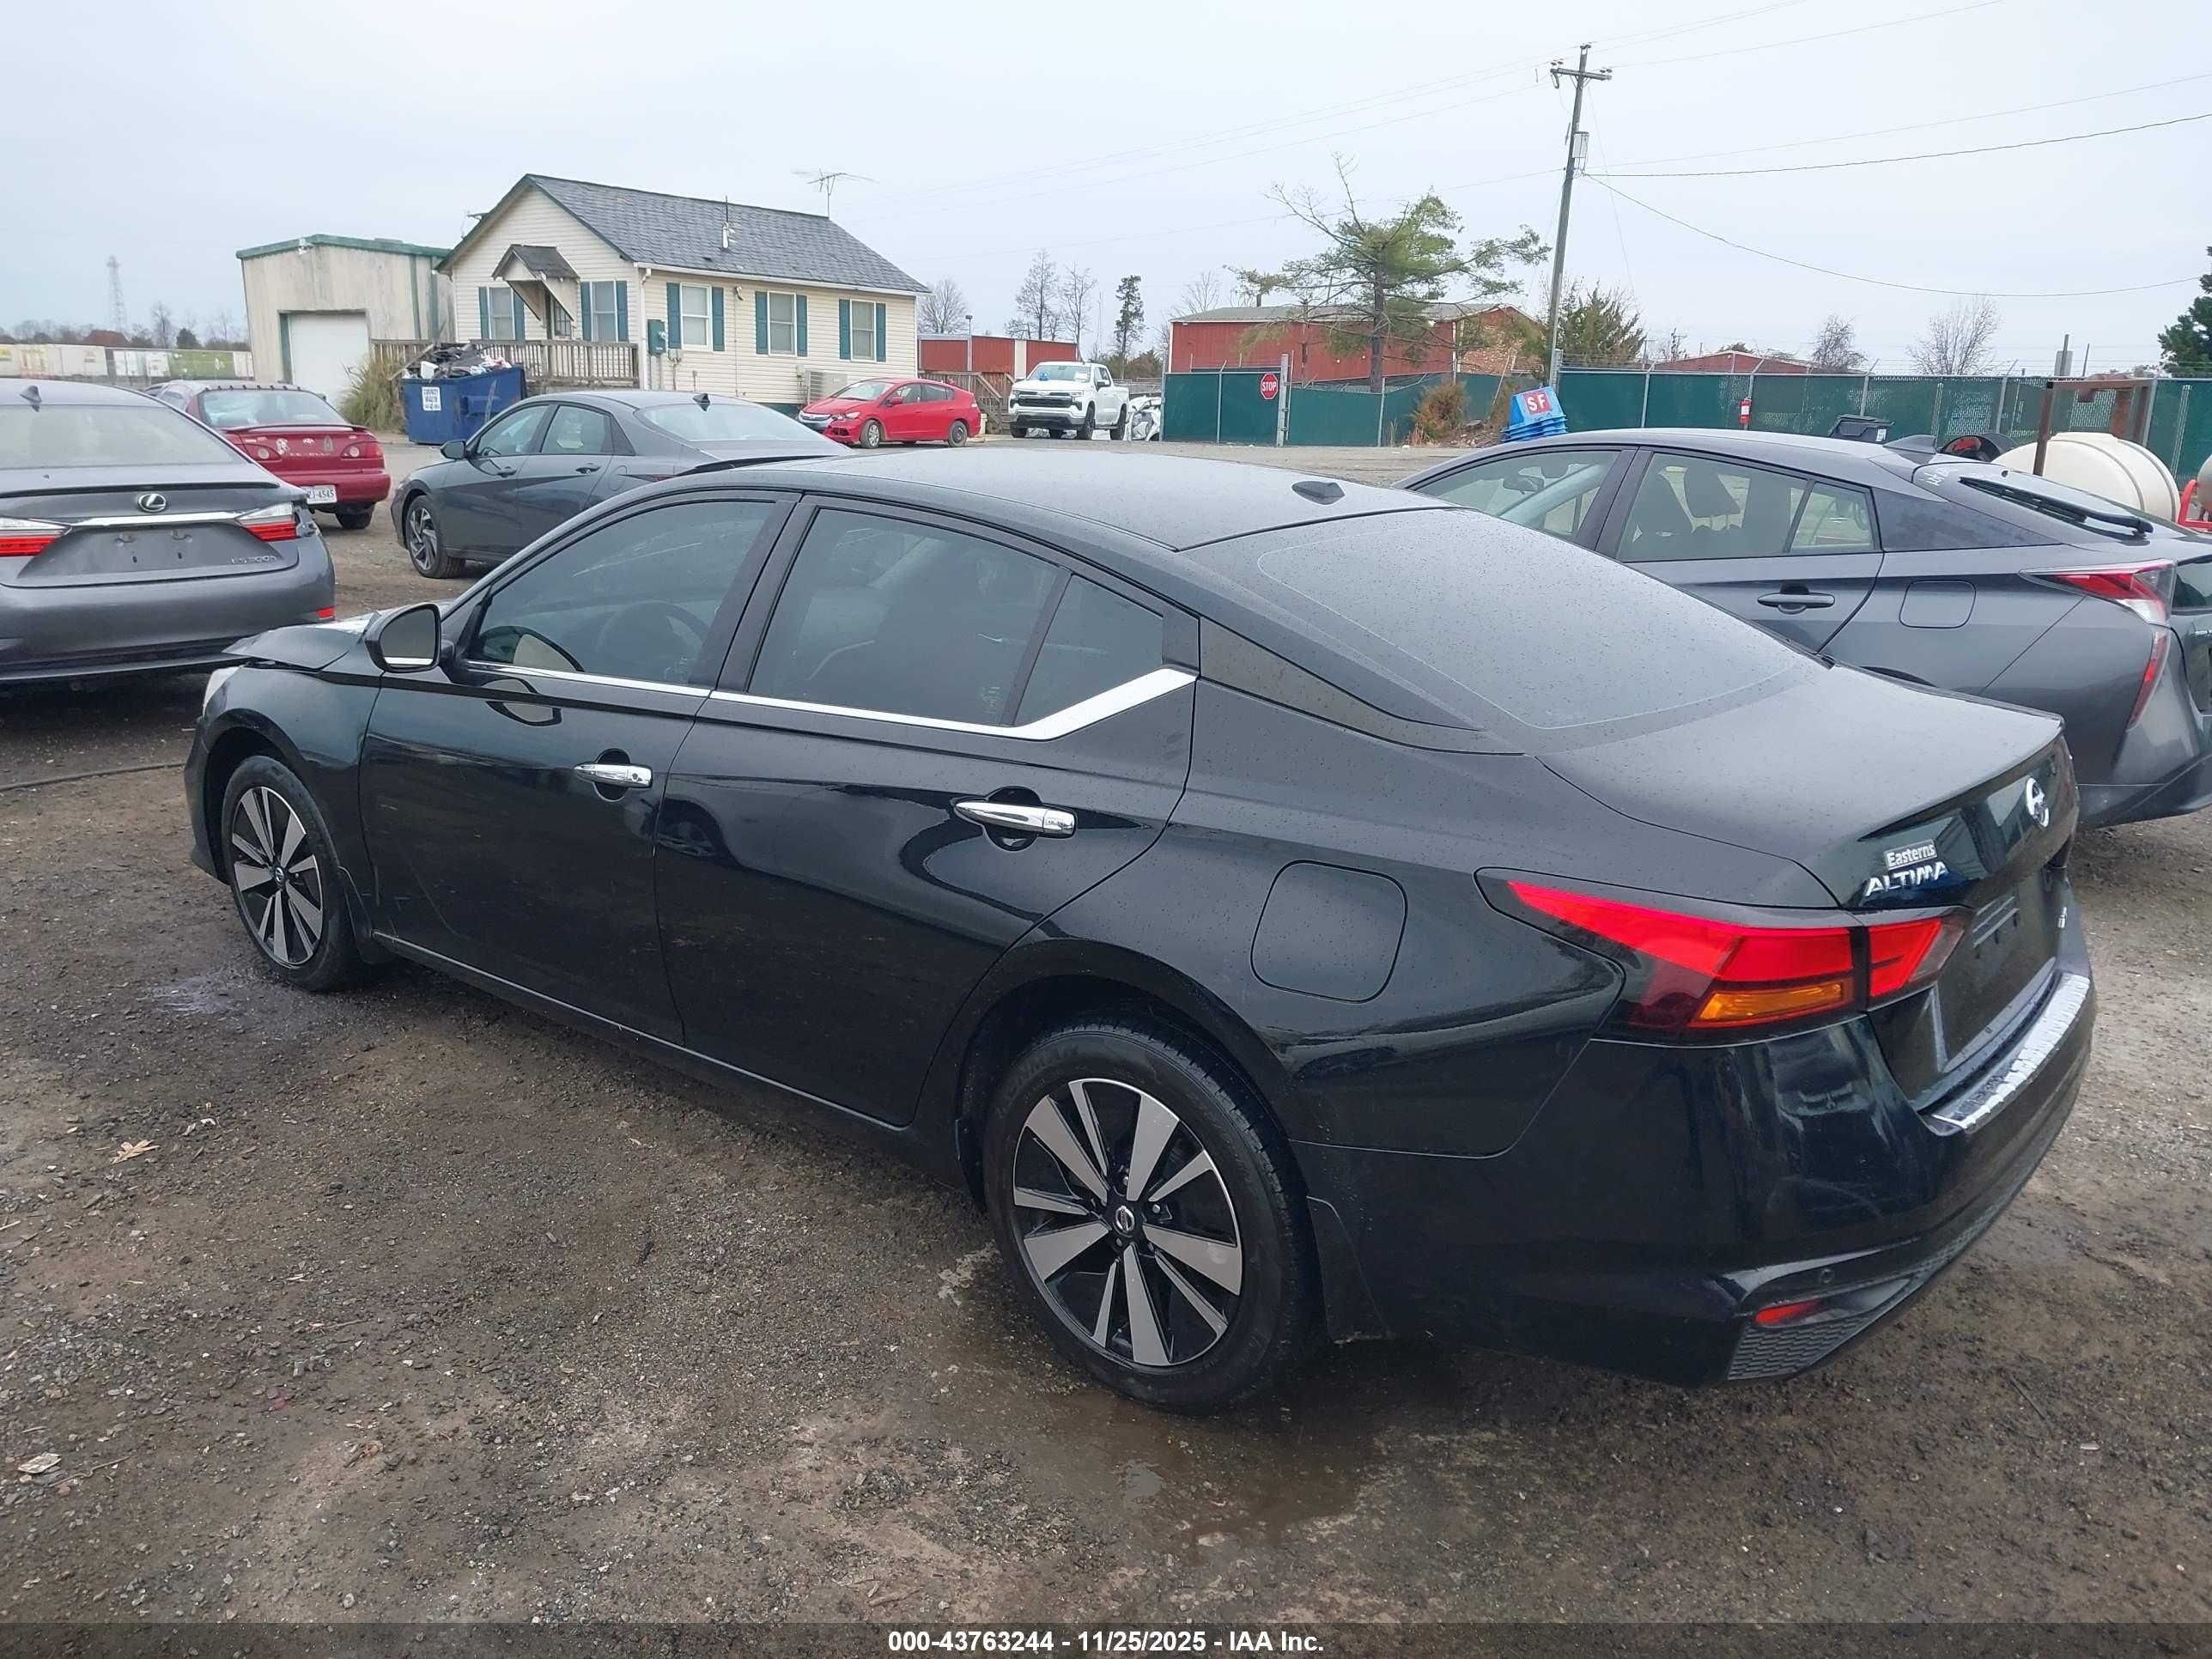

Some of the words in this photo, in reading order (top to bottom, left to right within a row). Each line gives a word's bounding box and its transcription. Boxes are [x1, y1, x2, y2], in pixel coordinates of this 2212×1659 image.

[1262, 381, 1277, 392] STOP
[1887, 844, 1936, 867] Easterns
[1863, 861, 1949, 896] ALTIMA
